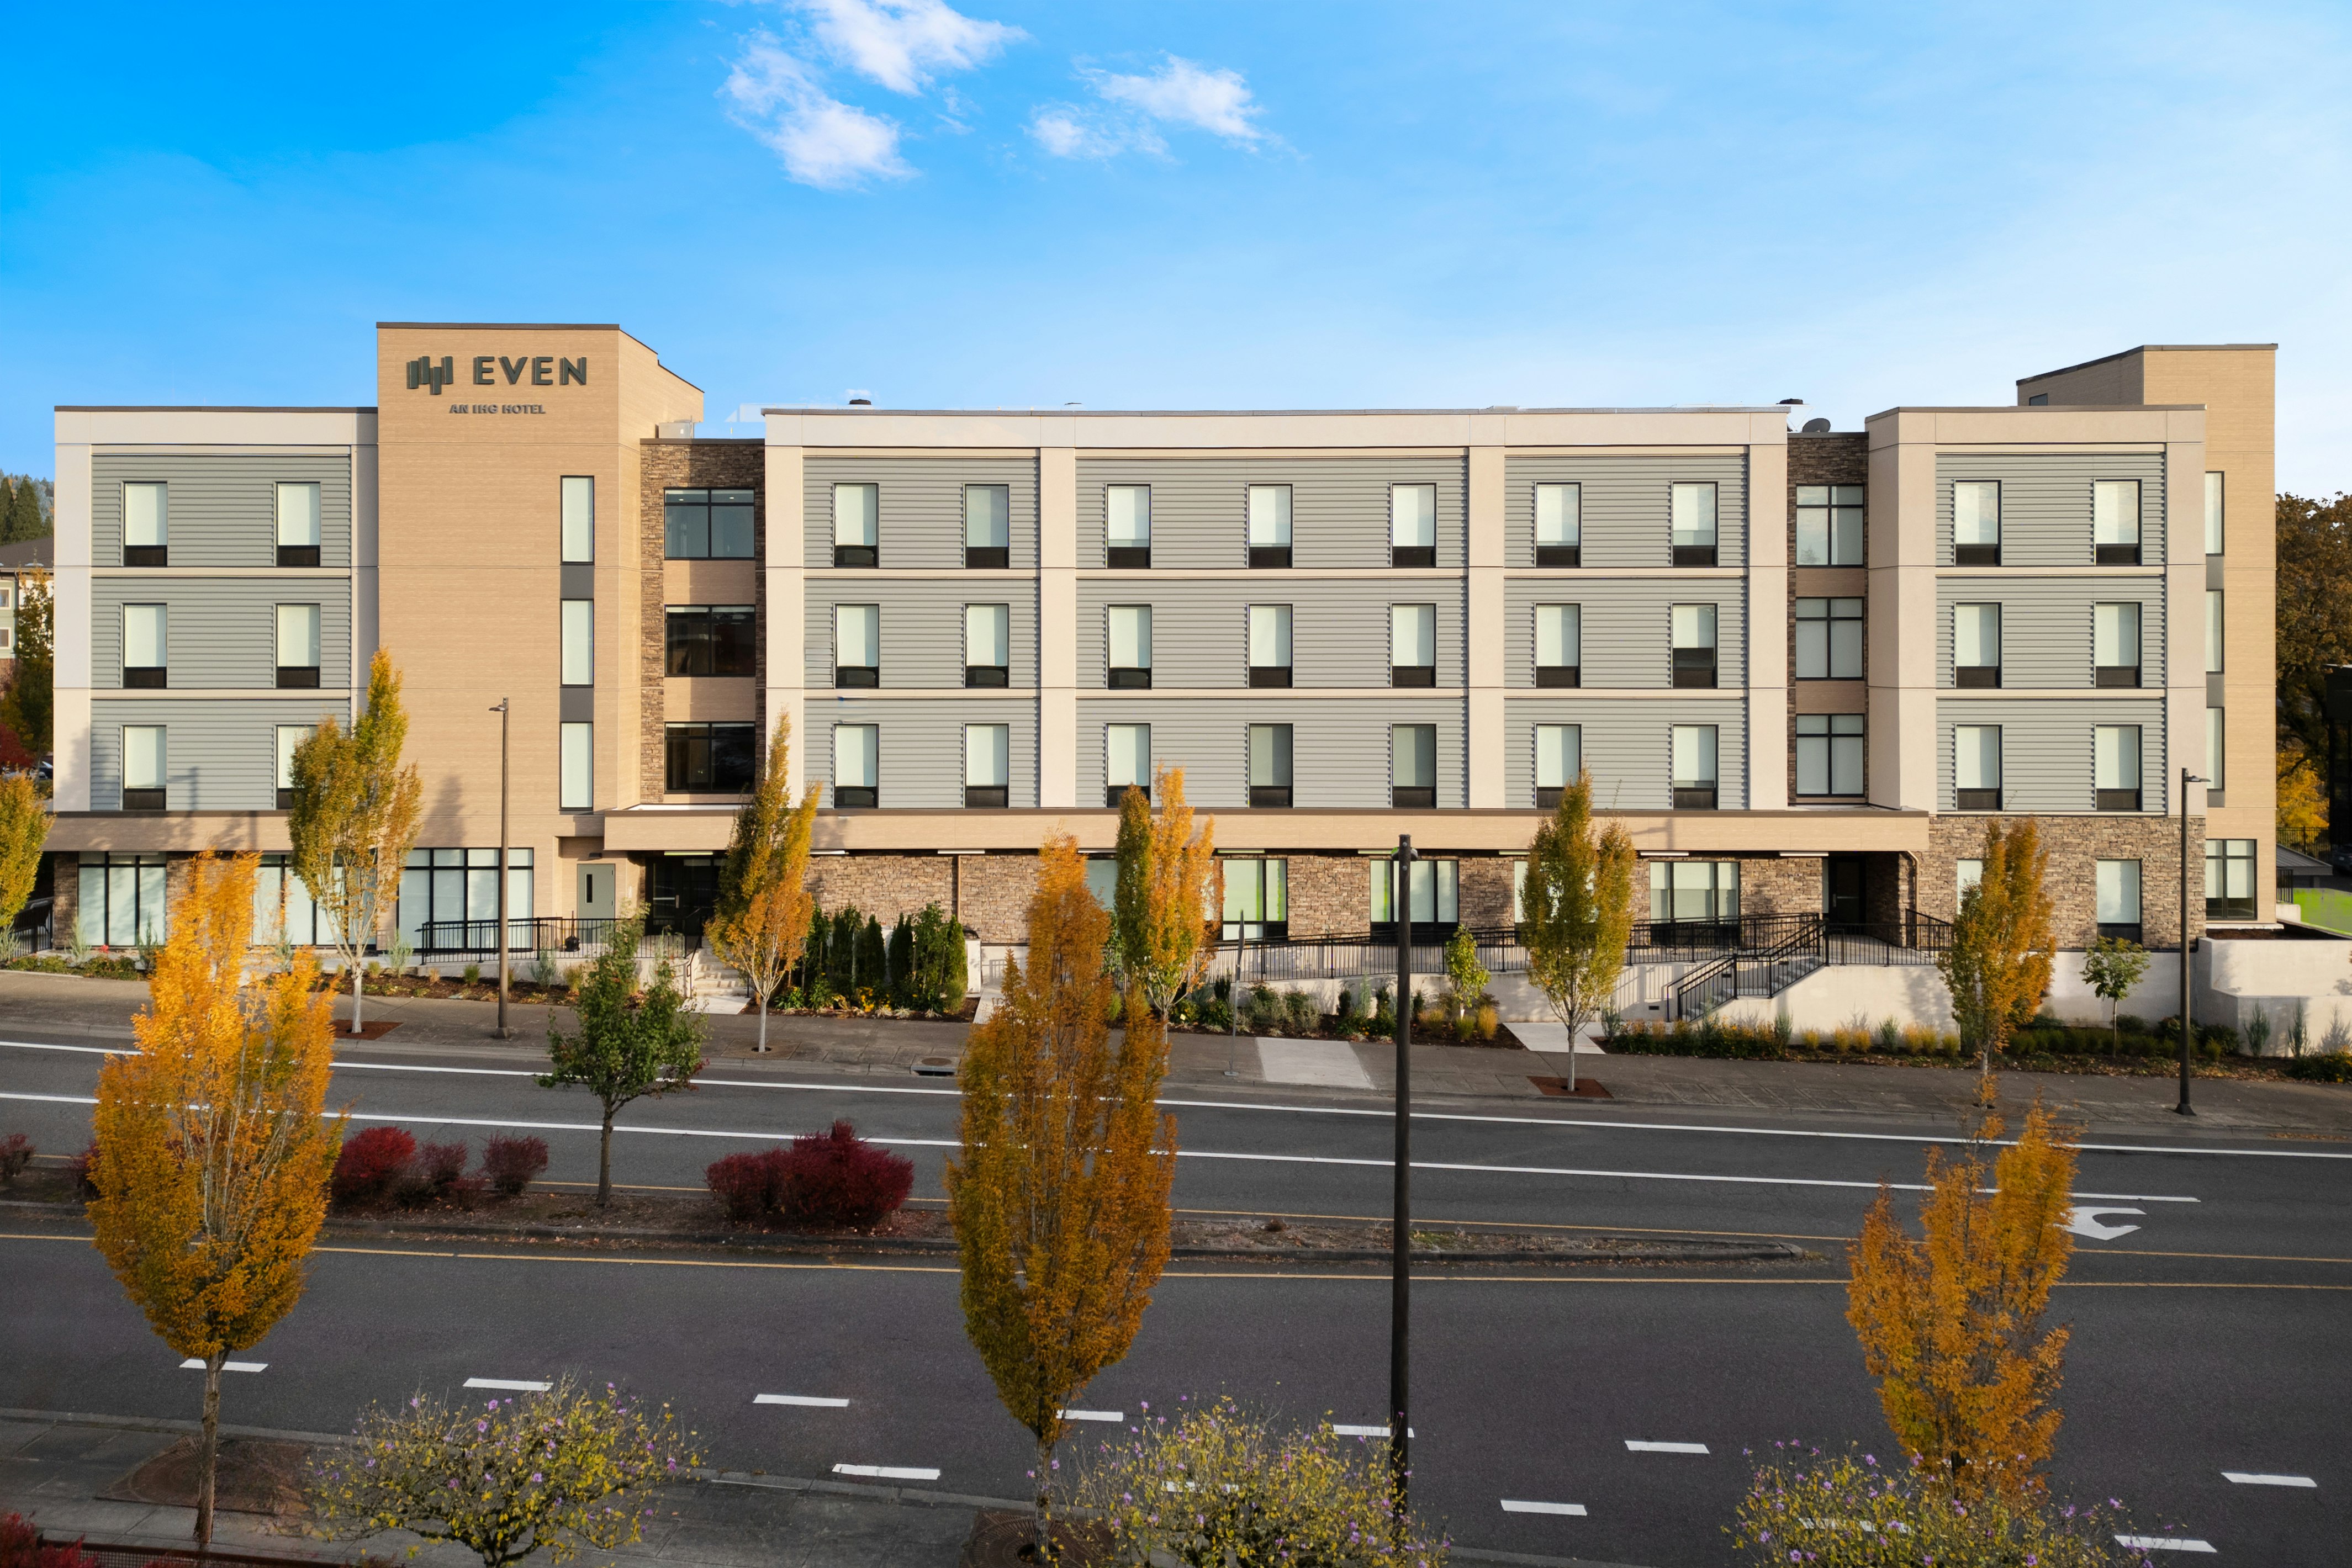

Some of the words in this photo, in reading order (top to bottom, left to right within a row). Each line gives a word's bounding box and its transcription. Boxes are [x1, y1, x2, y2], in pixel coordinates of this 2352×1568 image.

[475, 356, 586, 385] EVEN
[450, 404, 468, 414] AN
[473, 404, 498, 414] IHG
[502, 404, 546, 414] HOTEL
